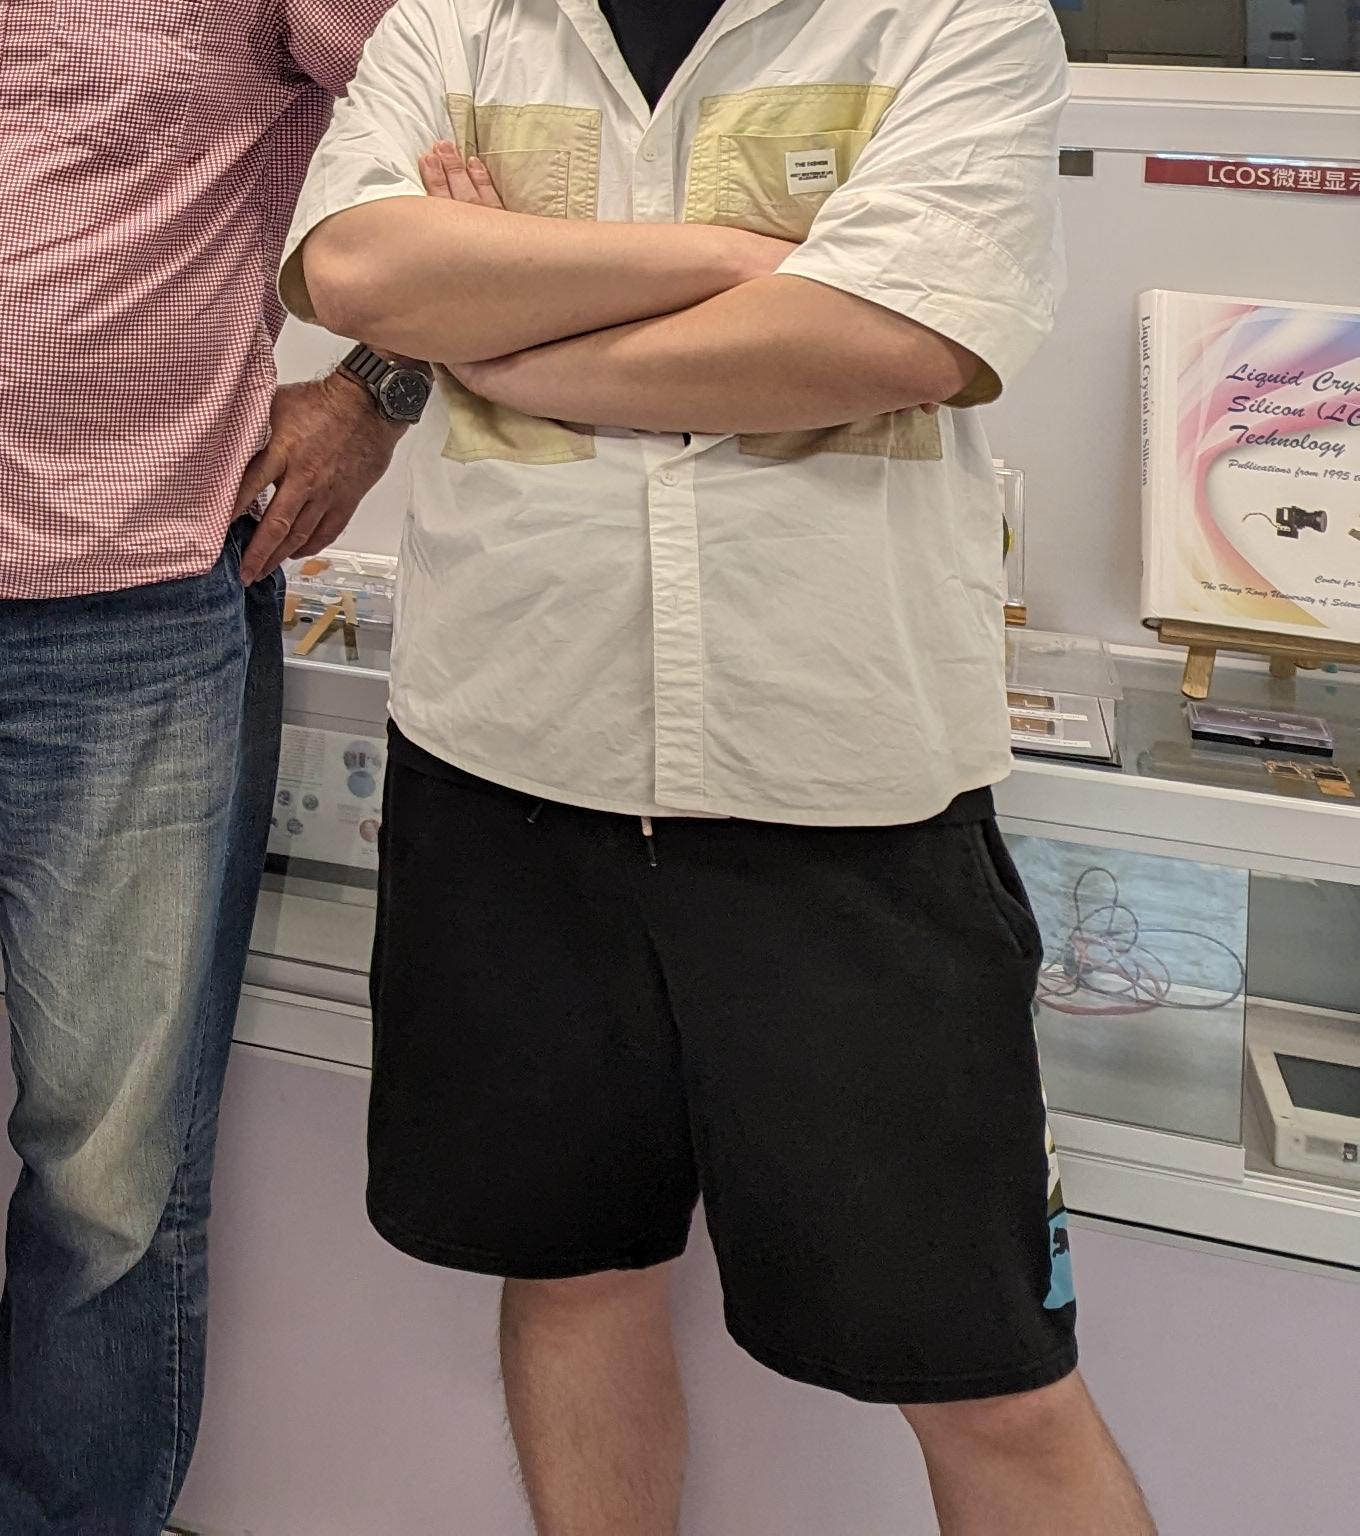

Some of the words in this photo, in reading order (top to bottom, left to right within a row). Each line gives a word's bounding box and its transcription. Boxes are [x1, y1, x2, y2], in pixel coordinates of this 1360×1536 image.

[1225, 363, 1305, 388] Liquid
[1227, 395, 1305, 417] Silicon
[1228, 424, 1346, 459] Technology
[1228, 459, 1291, 475] Publications
[1294, 467, 1319, 478] from
[1323, 469, 1351, 481] 1995
[1201, 581, 1217, 591] The
[1219, 583, 1242, 595] Hong
[1245, 587, 1268, 598] Kong
[1271, 590, 1315, 605] University
[1319, 597, 1328, 607] of
